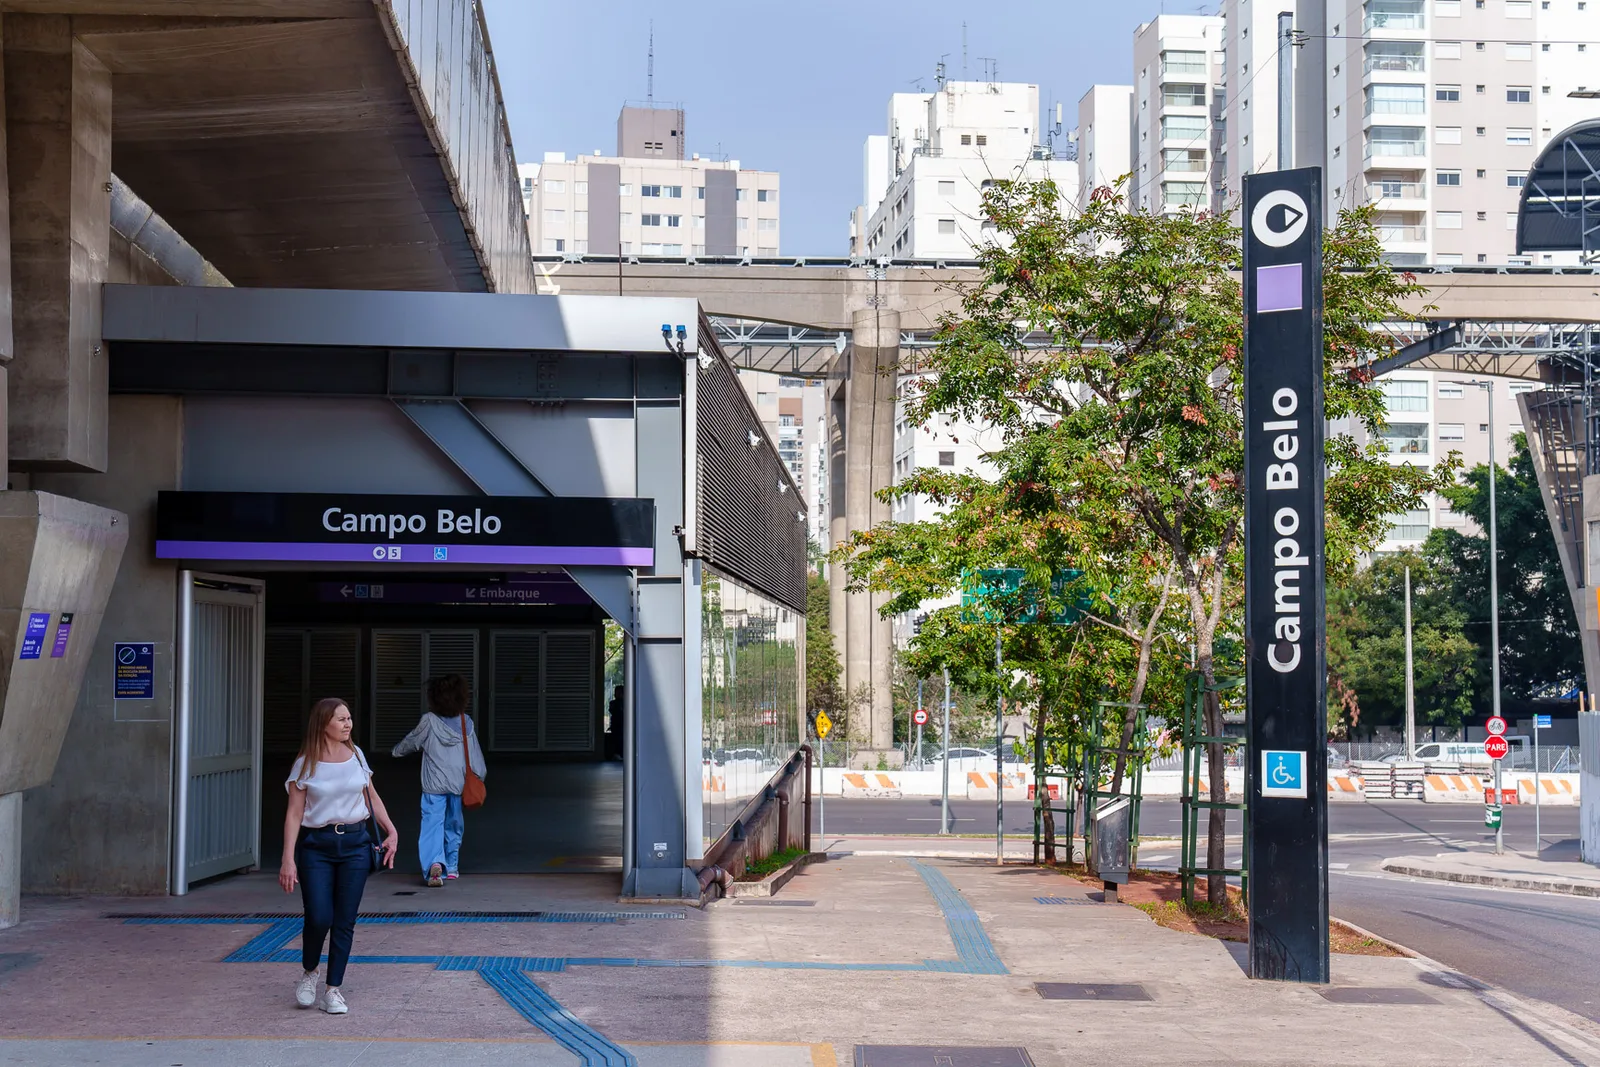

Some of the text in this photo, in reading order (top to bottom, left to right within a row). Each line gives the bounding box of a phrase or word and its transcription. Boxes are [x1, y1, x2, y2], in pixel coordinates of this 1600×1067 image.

[322, 507, 502, 538] Campo Belo
[1263, 387, 1309, 673] Campo Belo
[391, 548, 398, 558] 5
[480, 587, 540, 600] Embarque
[1486, 743, 1507, 751] PARE
